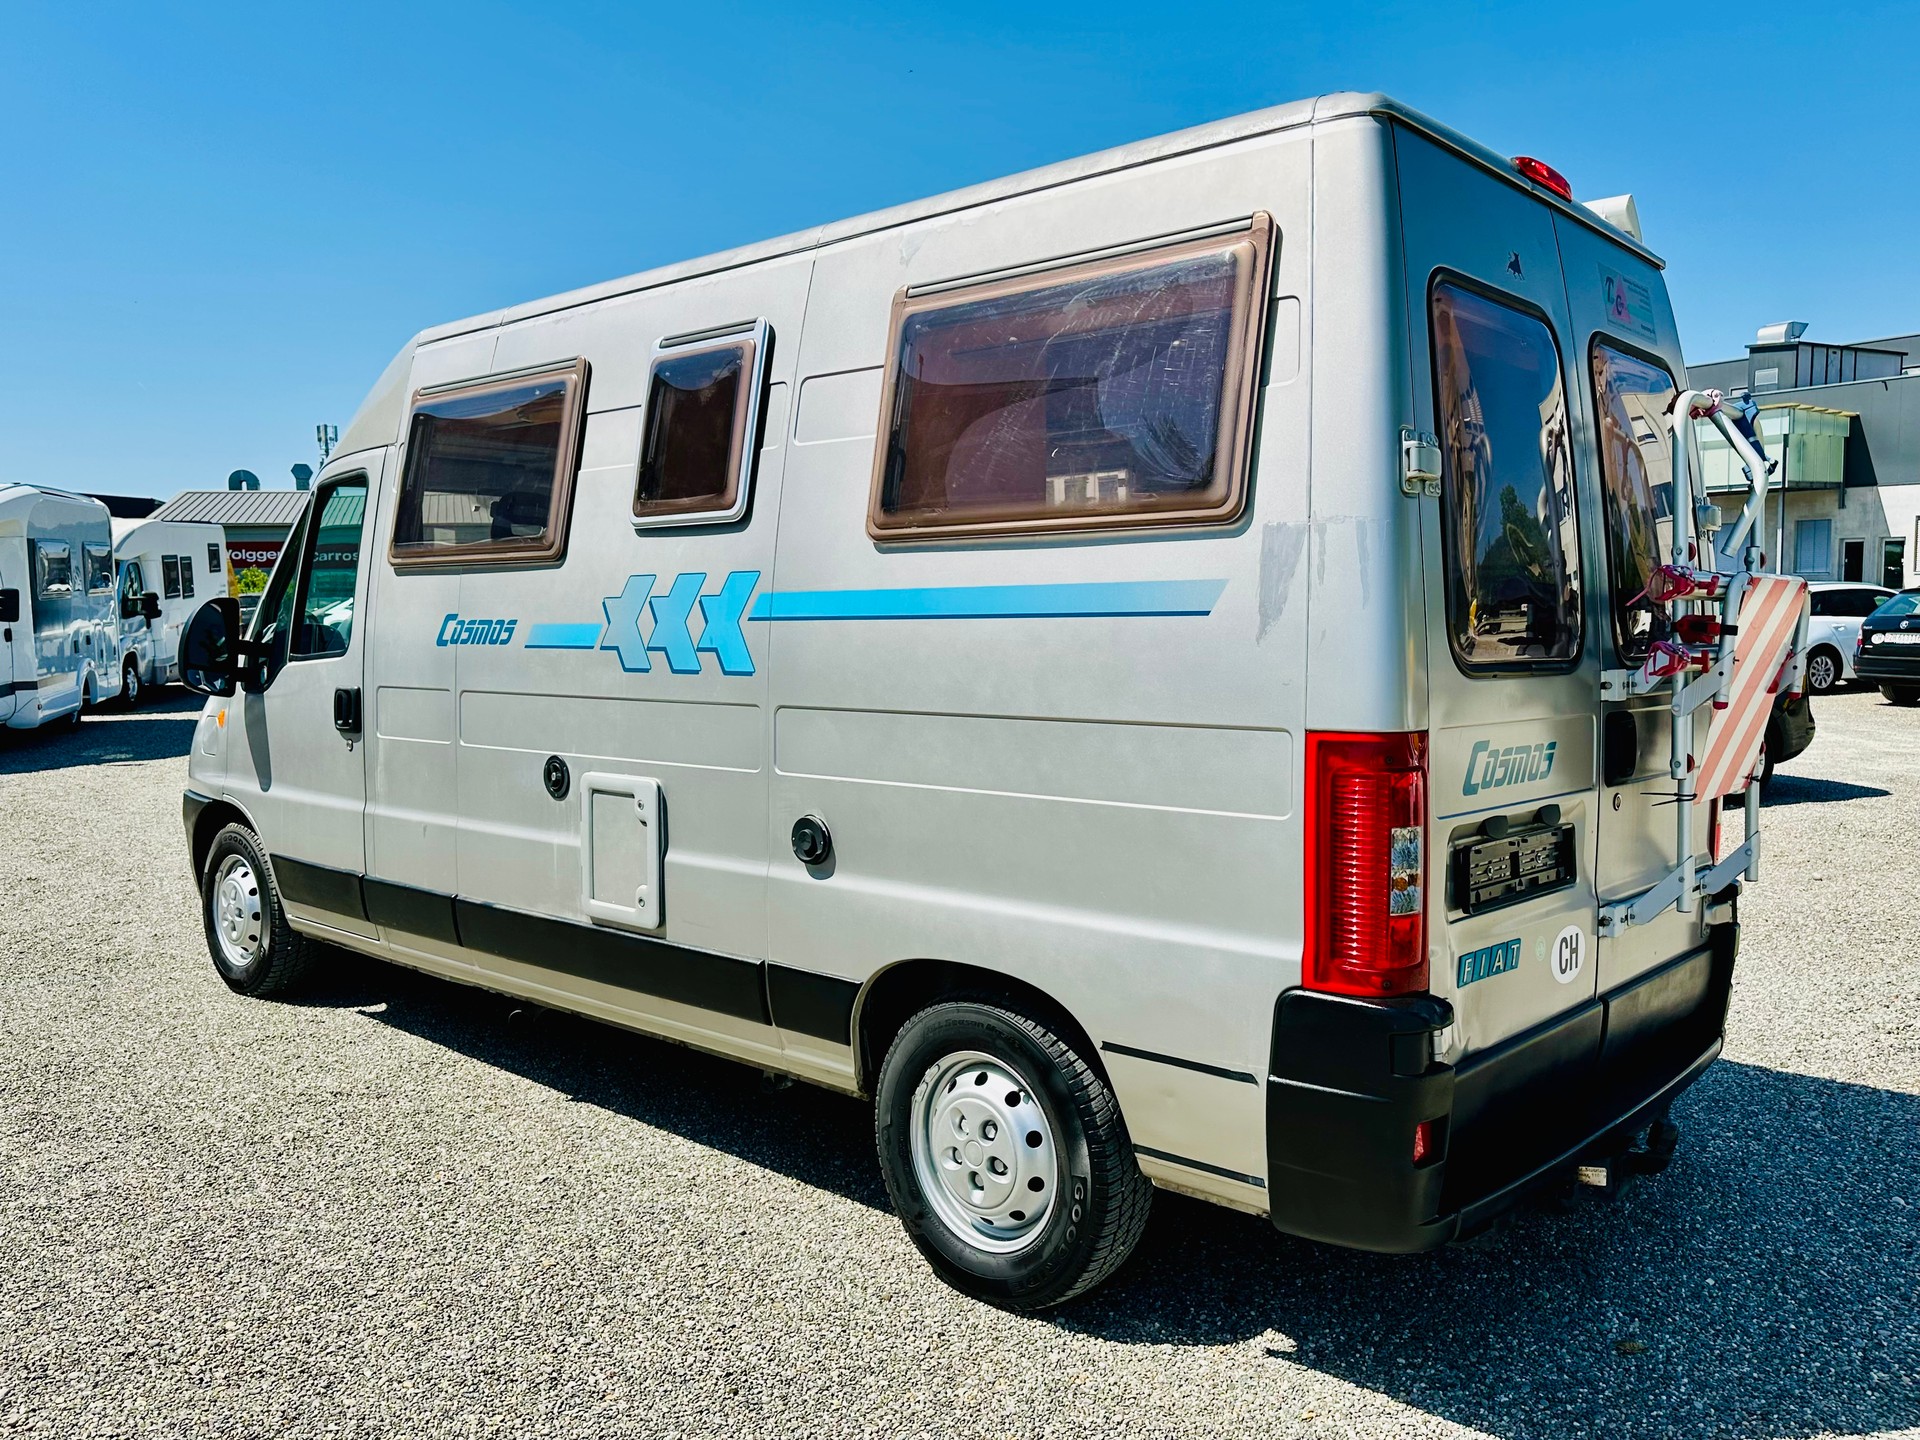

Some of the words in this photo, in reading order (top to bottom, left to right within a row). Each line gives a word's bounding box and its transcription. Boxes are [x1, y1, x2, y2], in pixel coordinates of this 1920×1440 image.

[436, 613, 518, 647] Cosmos
[1462, 739, 1557, 796] Cosmos
[1462, 943, 1520, 983] FIAT
[1558, 932, 1579, 975] CH
